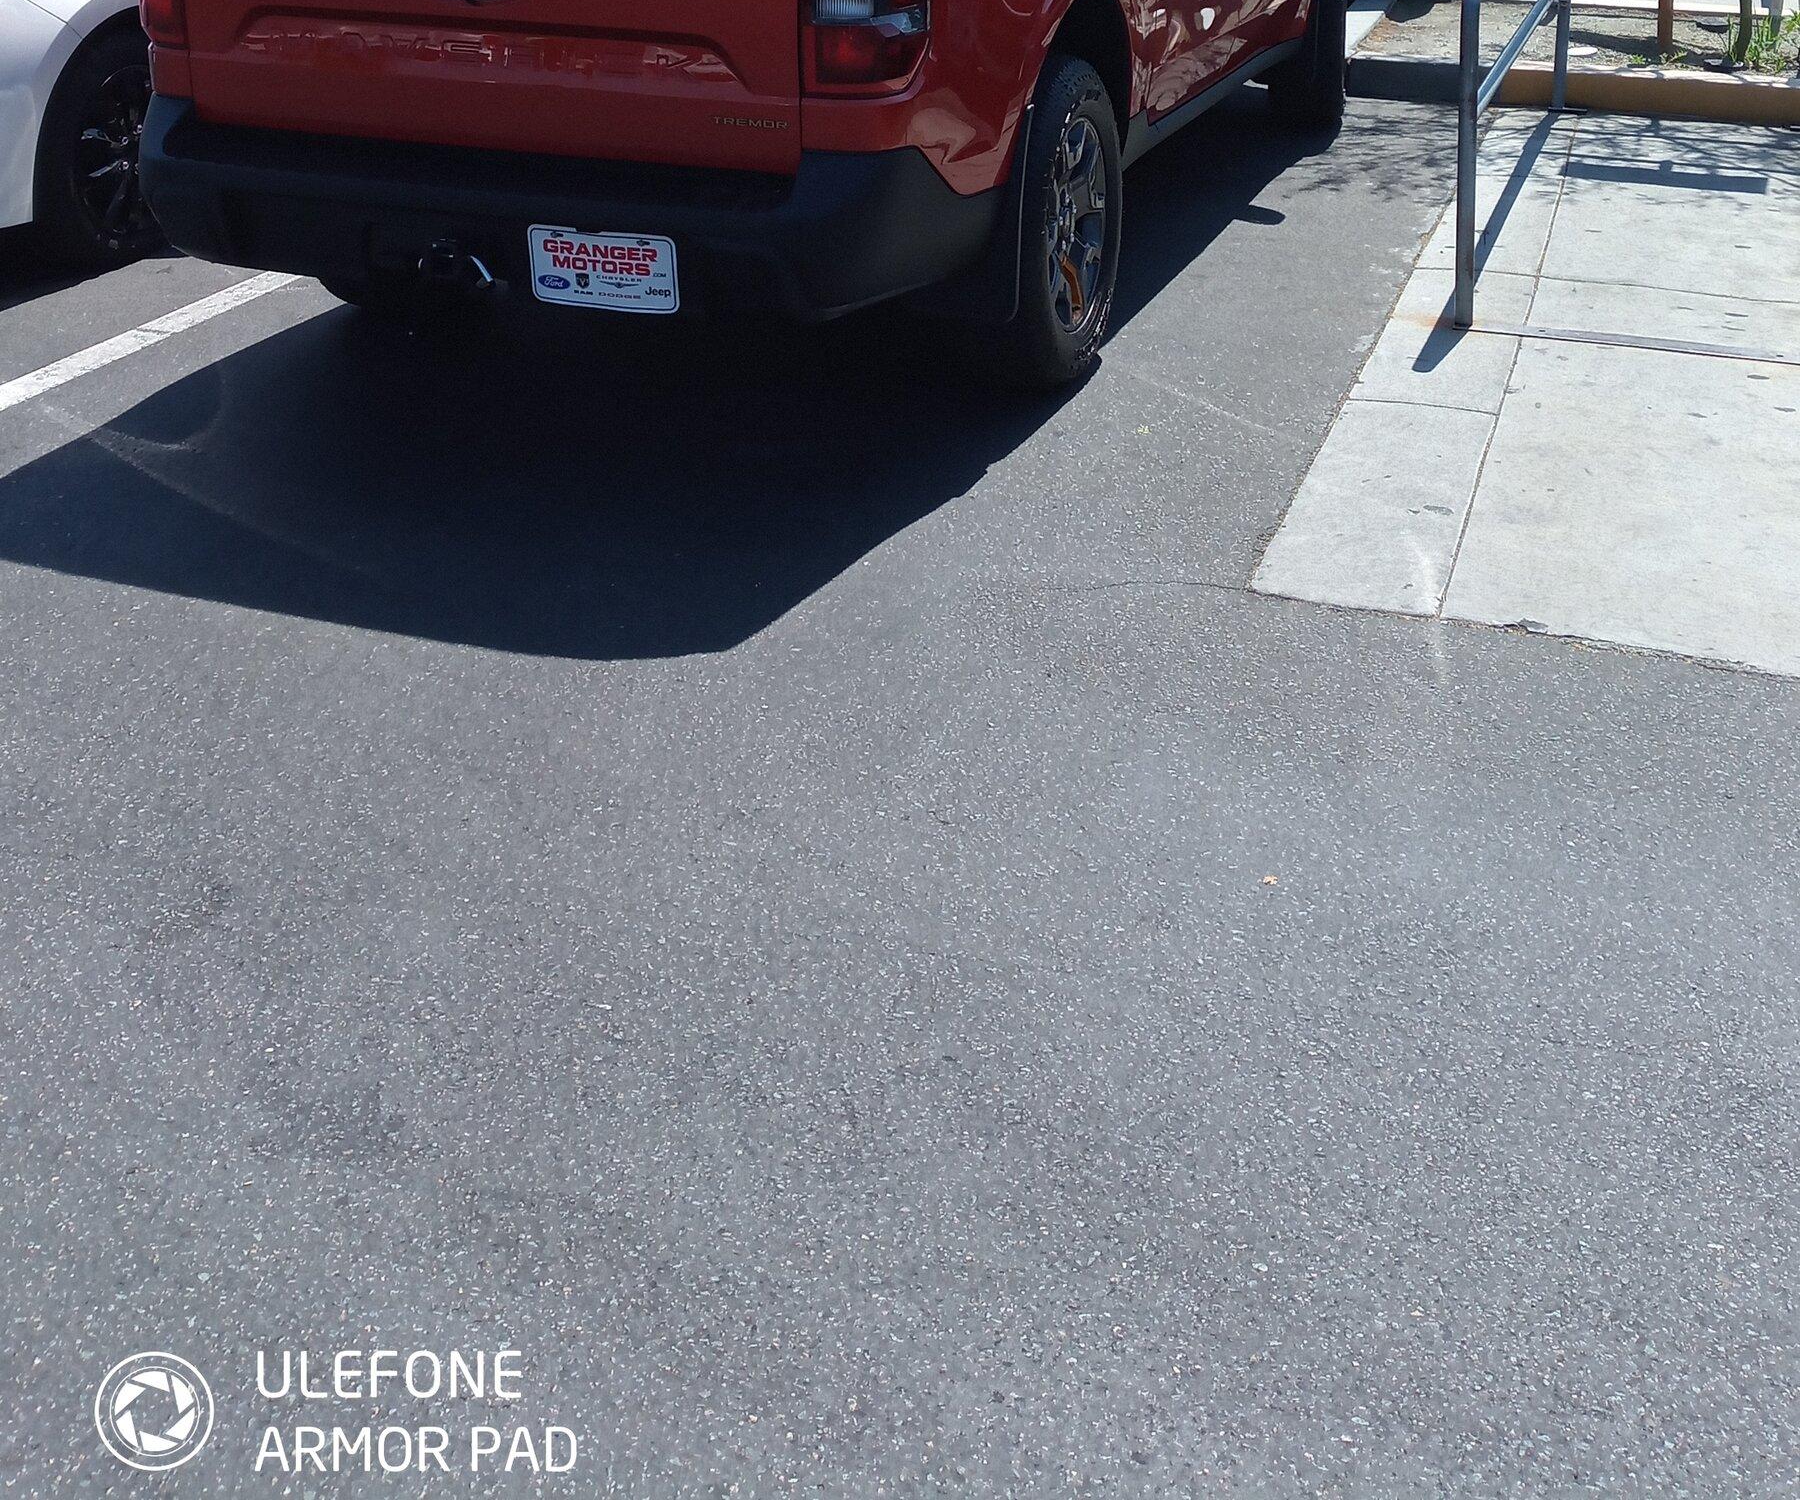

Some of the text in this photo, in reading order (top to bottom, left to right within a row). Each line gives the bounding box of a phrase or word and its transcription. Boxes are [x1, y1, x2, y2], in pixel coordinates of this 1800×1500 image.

[713, 116, 788, 129] TREMOR
[543, 239, 658, 263] GRANGER
[552, 254, 651, 277] MOTORS
[545, 273, 564, 287] Ford
[595, 274, 642, 283] CHRYSLER
[598, 291, 641, 300] DODGE
[645, 286, 671, 299] Jeep
